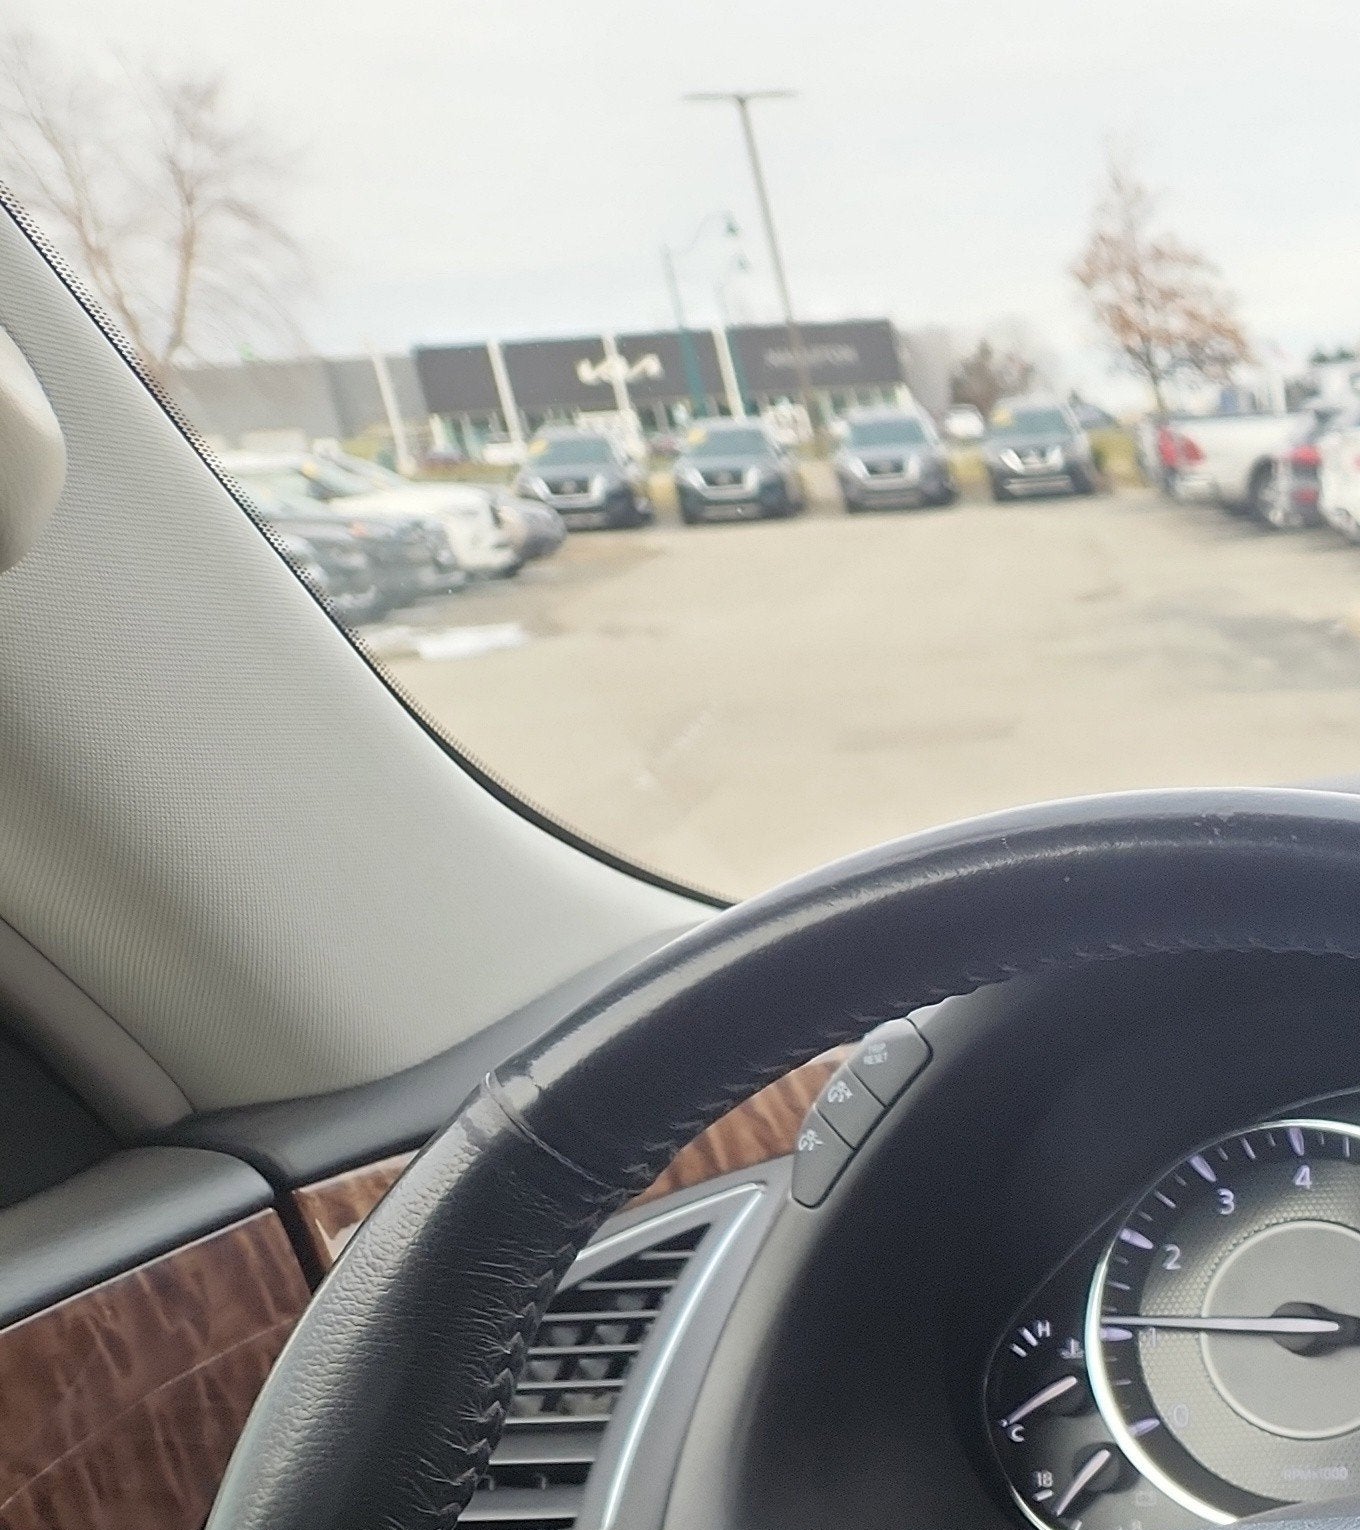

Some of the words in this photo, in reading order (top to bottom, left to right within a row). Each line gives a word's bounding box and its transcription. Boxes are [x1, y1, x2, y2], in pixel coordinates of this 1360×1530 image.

[1294, 1166, 1312, 1188] 4
[1217, 1191, 1236, 1215] 3
[1162, 1246, 1182, 1271] 2
[1036, 1320, 1050, 1338] H
[1172, 1403, 1190, 1428] 0
[1010, 1424, 1025, 1443] C
